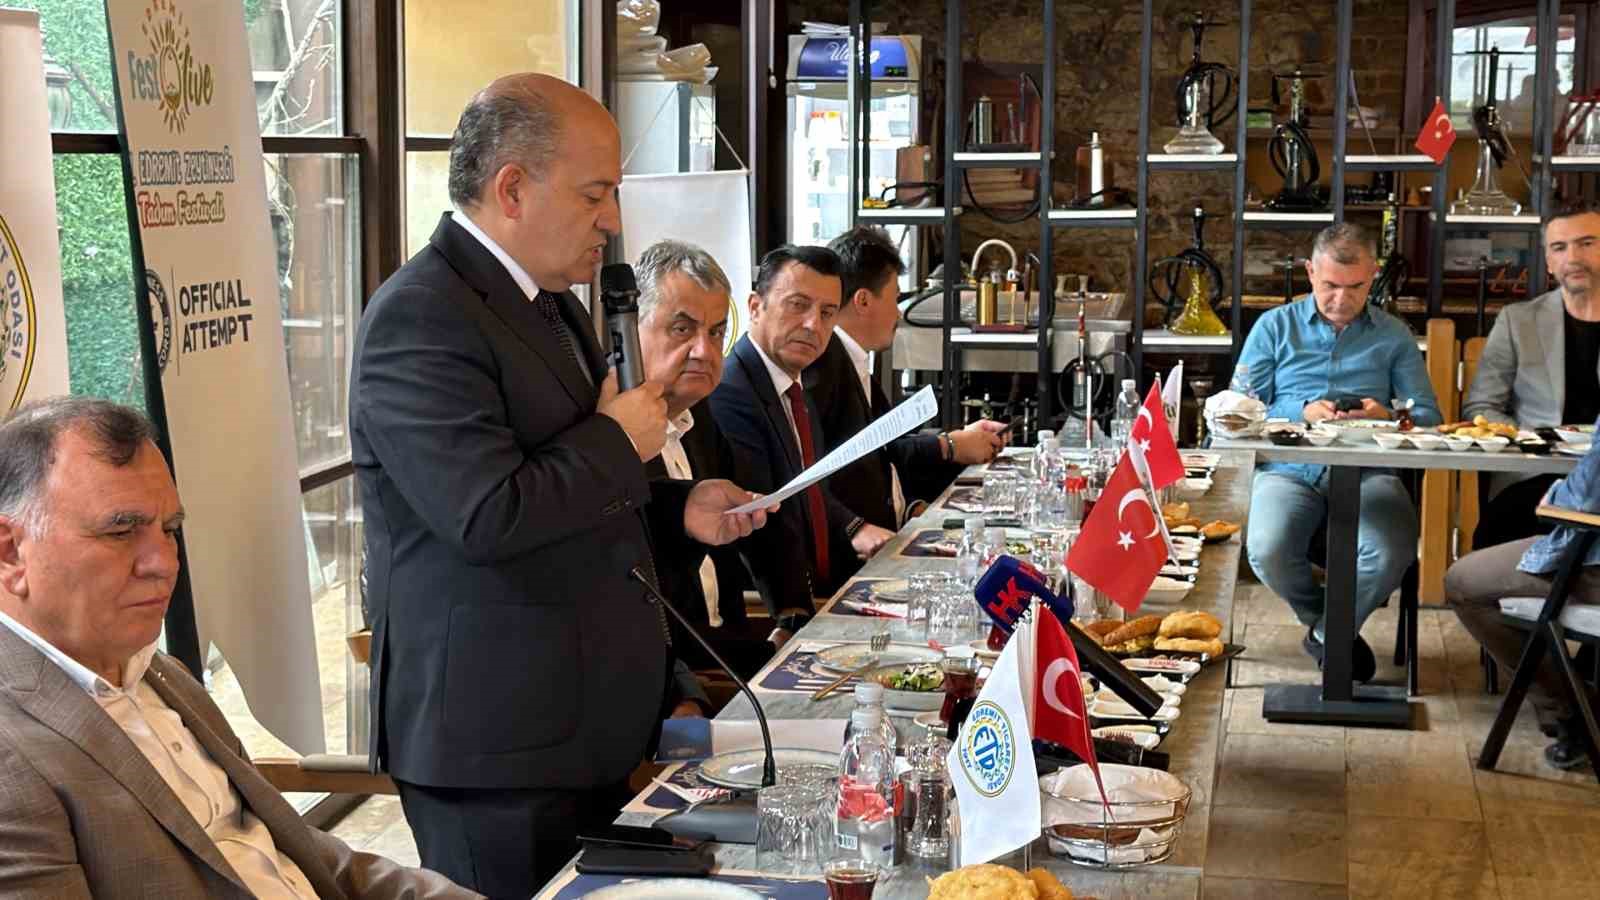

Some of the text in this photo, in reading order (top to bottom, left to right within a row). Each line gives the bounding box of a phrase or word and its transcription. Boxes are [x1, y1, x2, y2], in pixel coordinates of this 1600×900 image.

[6, 269, 23, 359] ODASI
[180, 279, 251, 317] OFFICIAL
[182, 314, 252, 354] ATTEMPT
